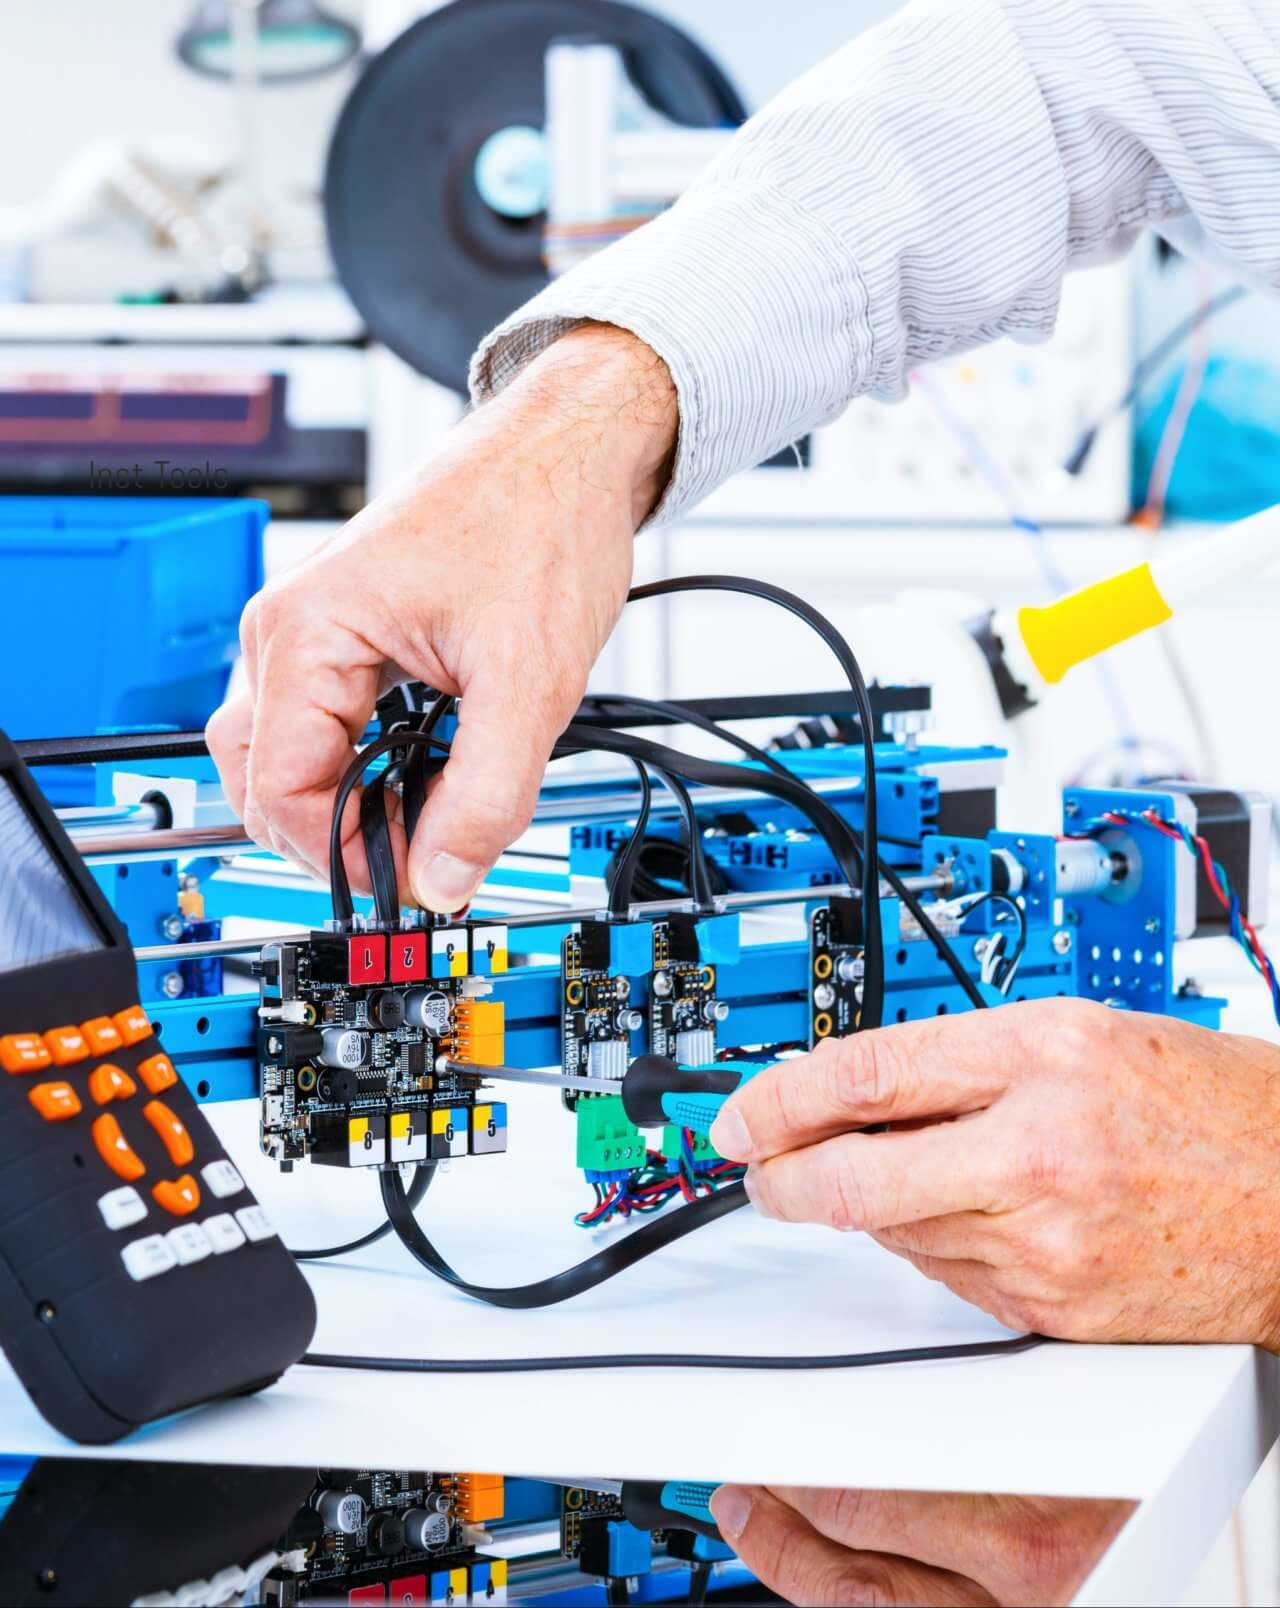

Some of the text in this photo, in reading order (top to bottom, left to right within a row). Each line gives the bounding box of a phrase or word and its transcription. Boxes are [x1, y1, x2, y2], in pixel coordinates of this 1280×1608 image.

[364, 948, 373, 970] 1
[404, 947, 413, 967] 2
[446, 943, 454, 962] 3
[487, 940, 495, 959] 4
[406, 1126, 414, 1146] 7
[445, 1122, 454, 1142] 6
[487, 1119, 496, 1137] 5
[364, 1130, 373, 1150] 8
